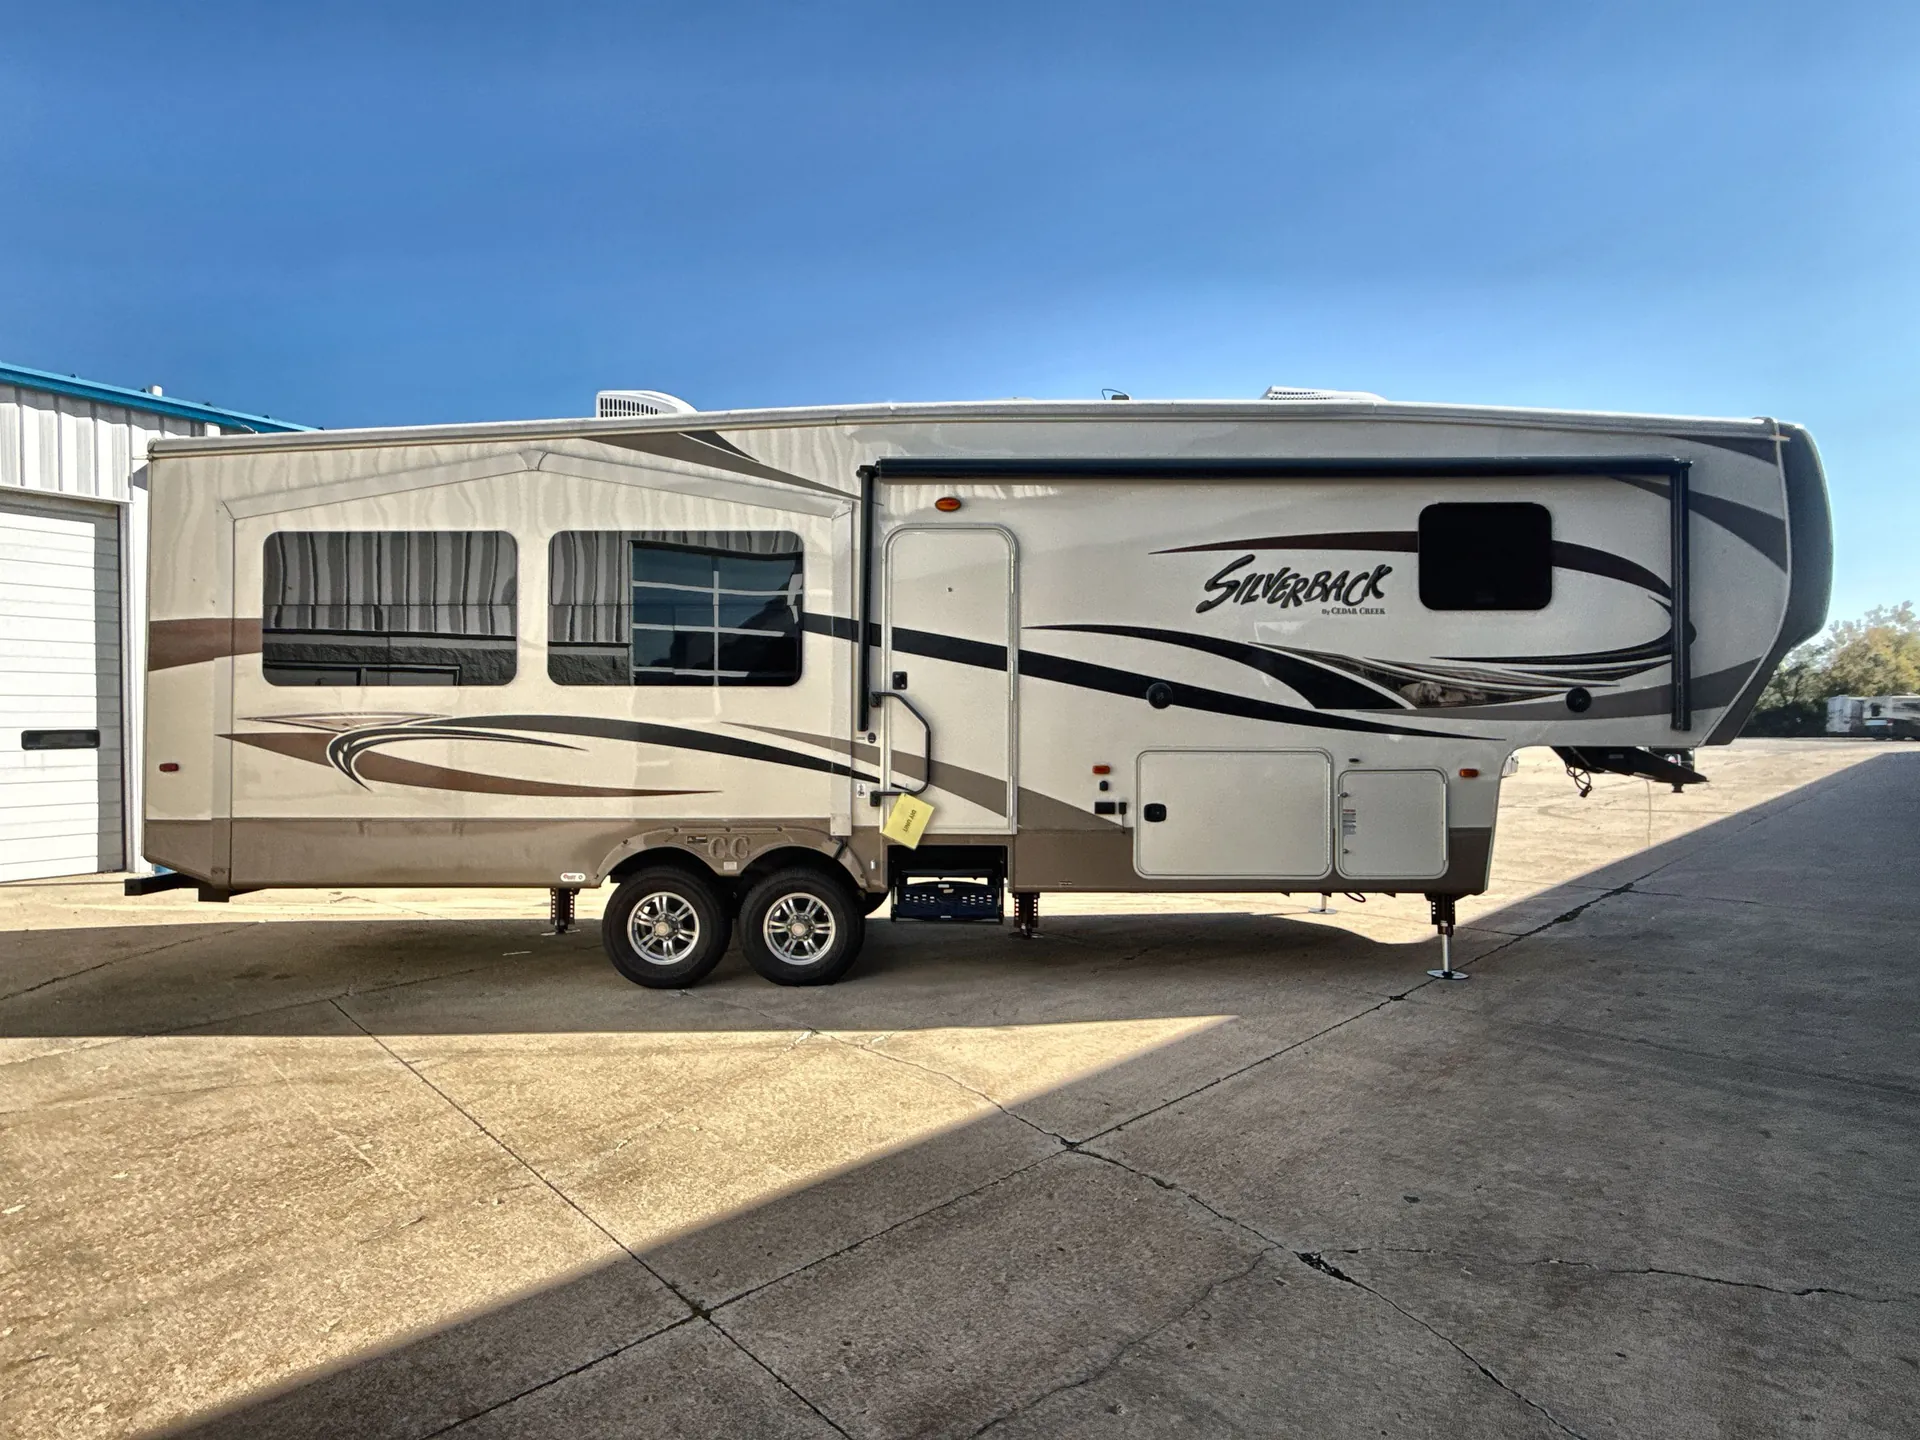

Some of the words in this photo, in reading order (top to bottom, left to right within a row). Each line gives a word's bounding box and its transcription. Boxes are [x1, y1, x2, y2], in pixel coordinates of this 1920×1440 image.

[1196, 554, 1393, 613] SILVERBACK
[1331, 607, 1357, 615] CEDAR
[1359, 607, 1386, 615] CREEK
